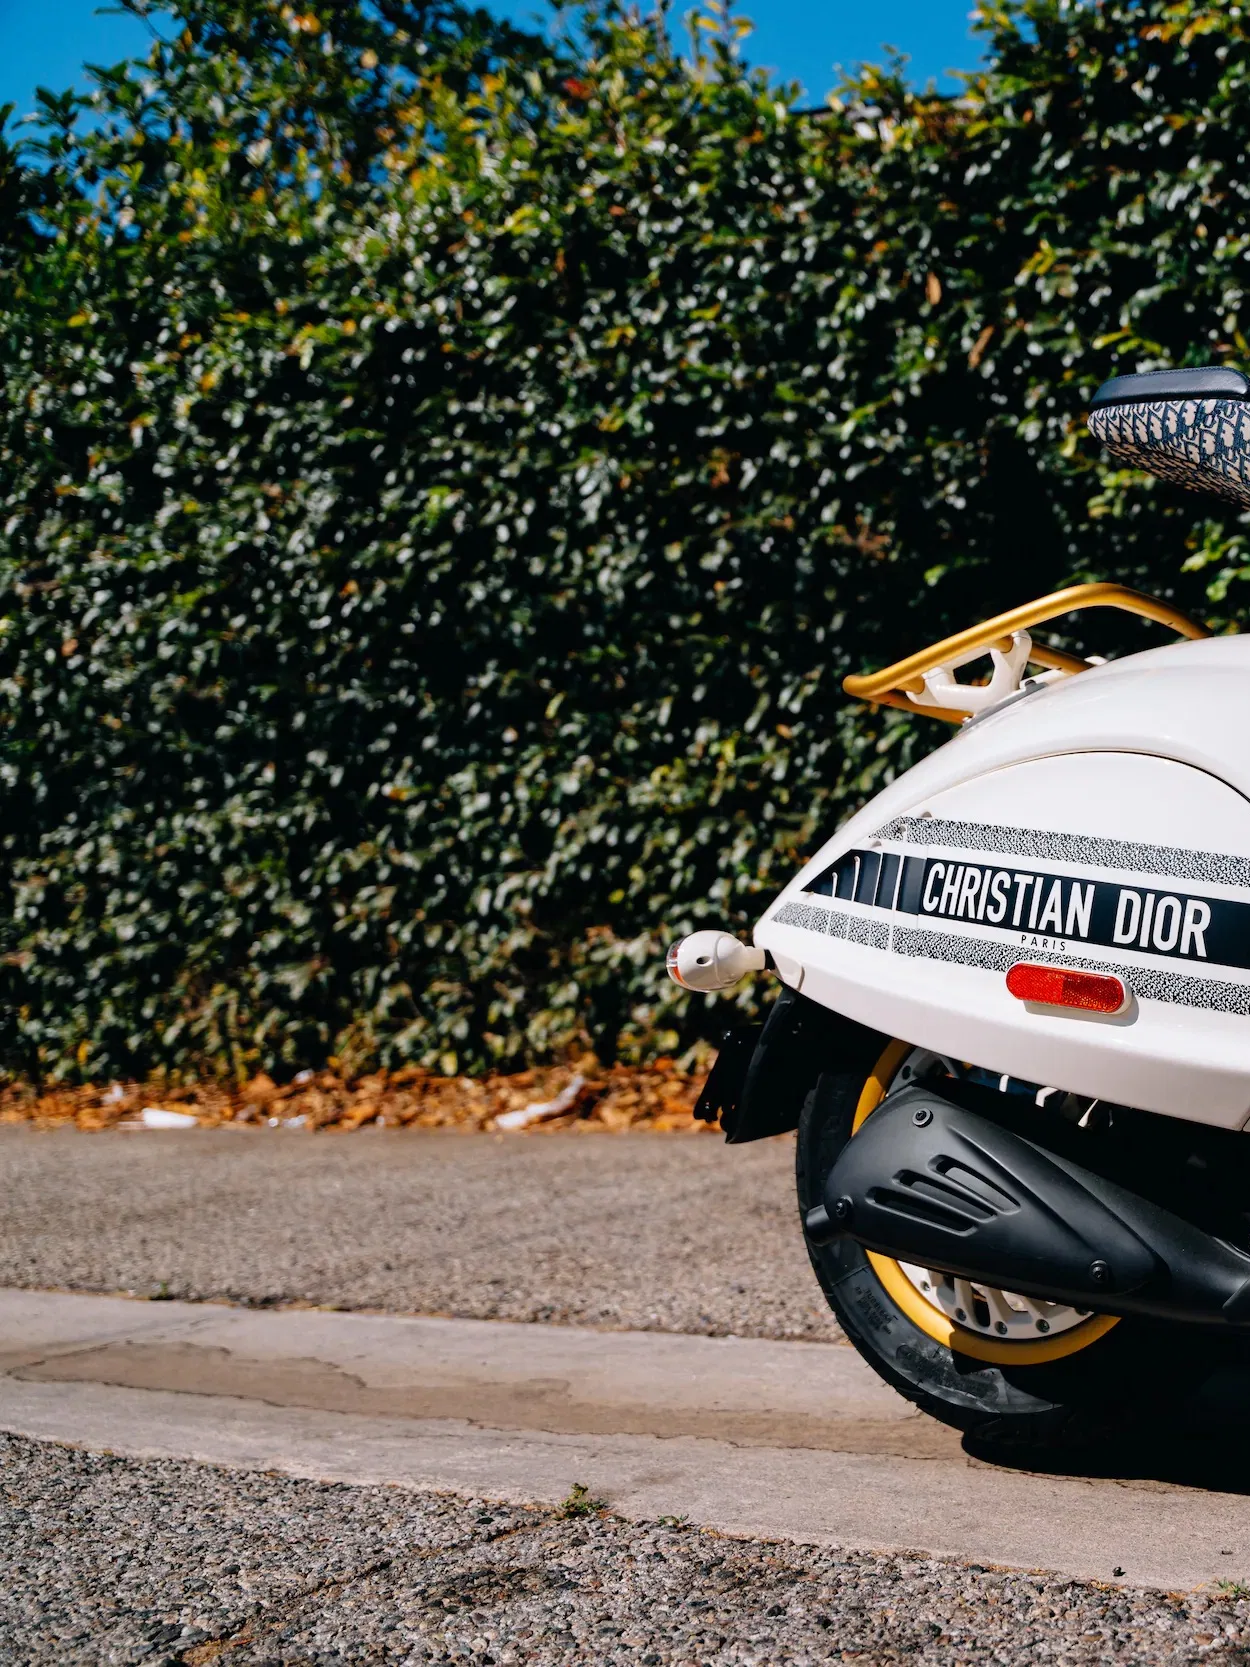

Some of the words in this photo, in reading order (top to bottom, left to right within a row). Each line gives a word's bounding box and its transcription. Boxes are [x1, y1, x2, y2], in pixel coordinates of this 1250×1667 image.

[922, 862, 1096, 938] CHRISTIAN
[1112, 889, 1211, 957] DIOR
[1021, 934, 1066, 951] PARIS
